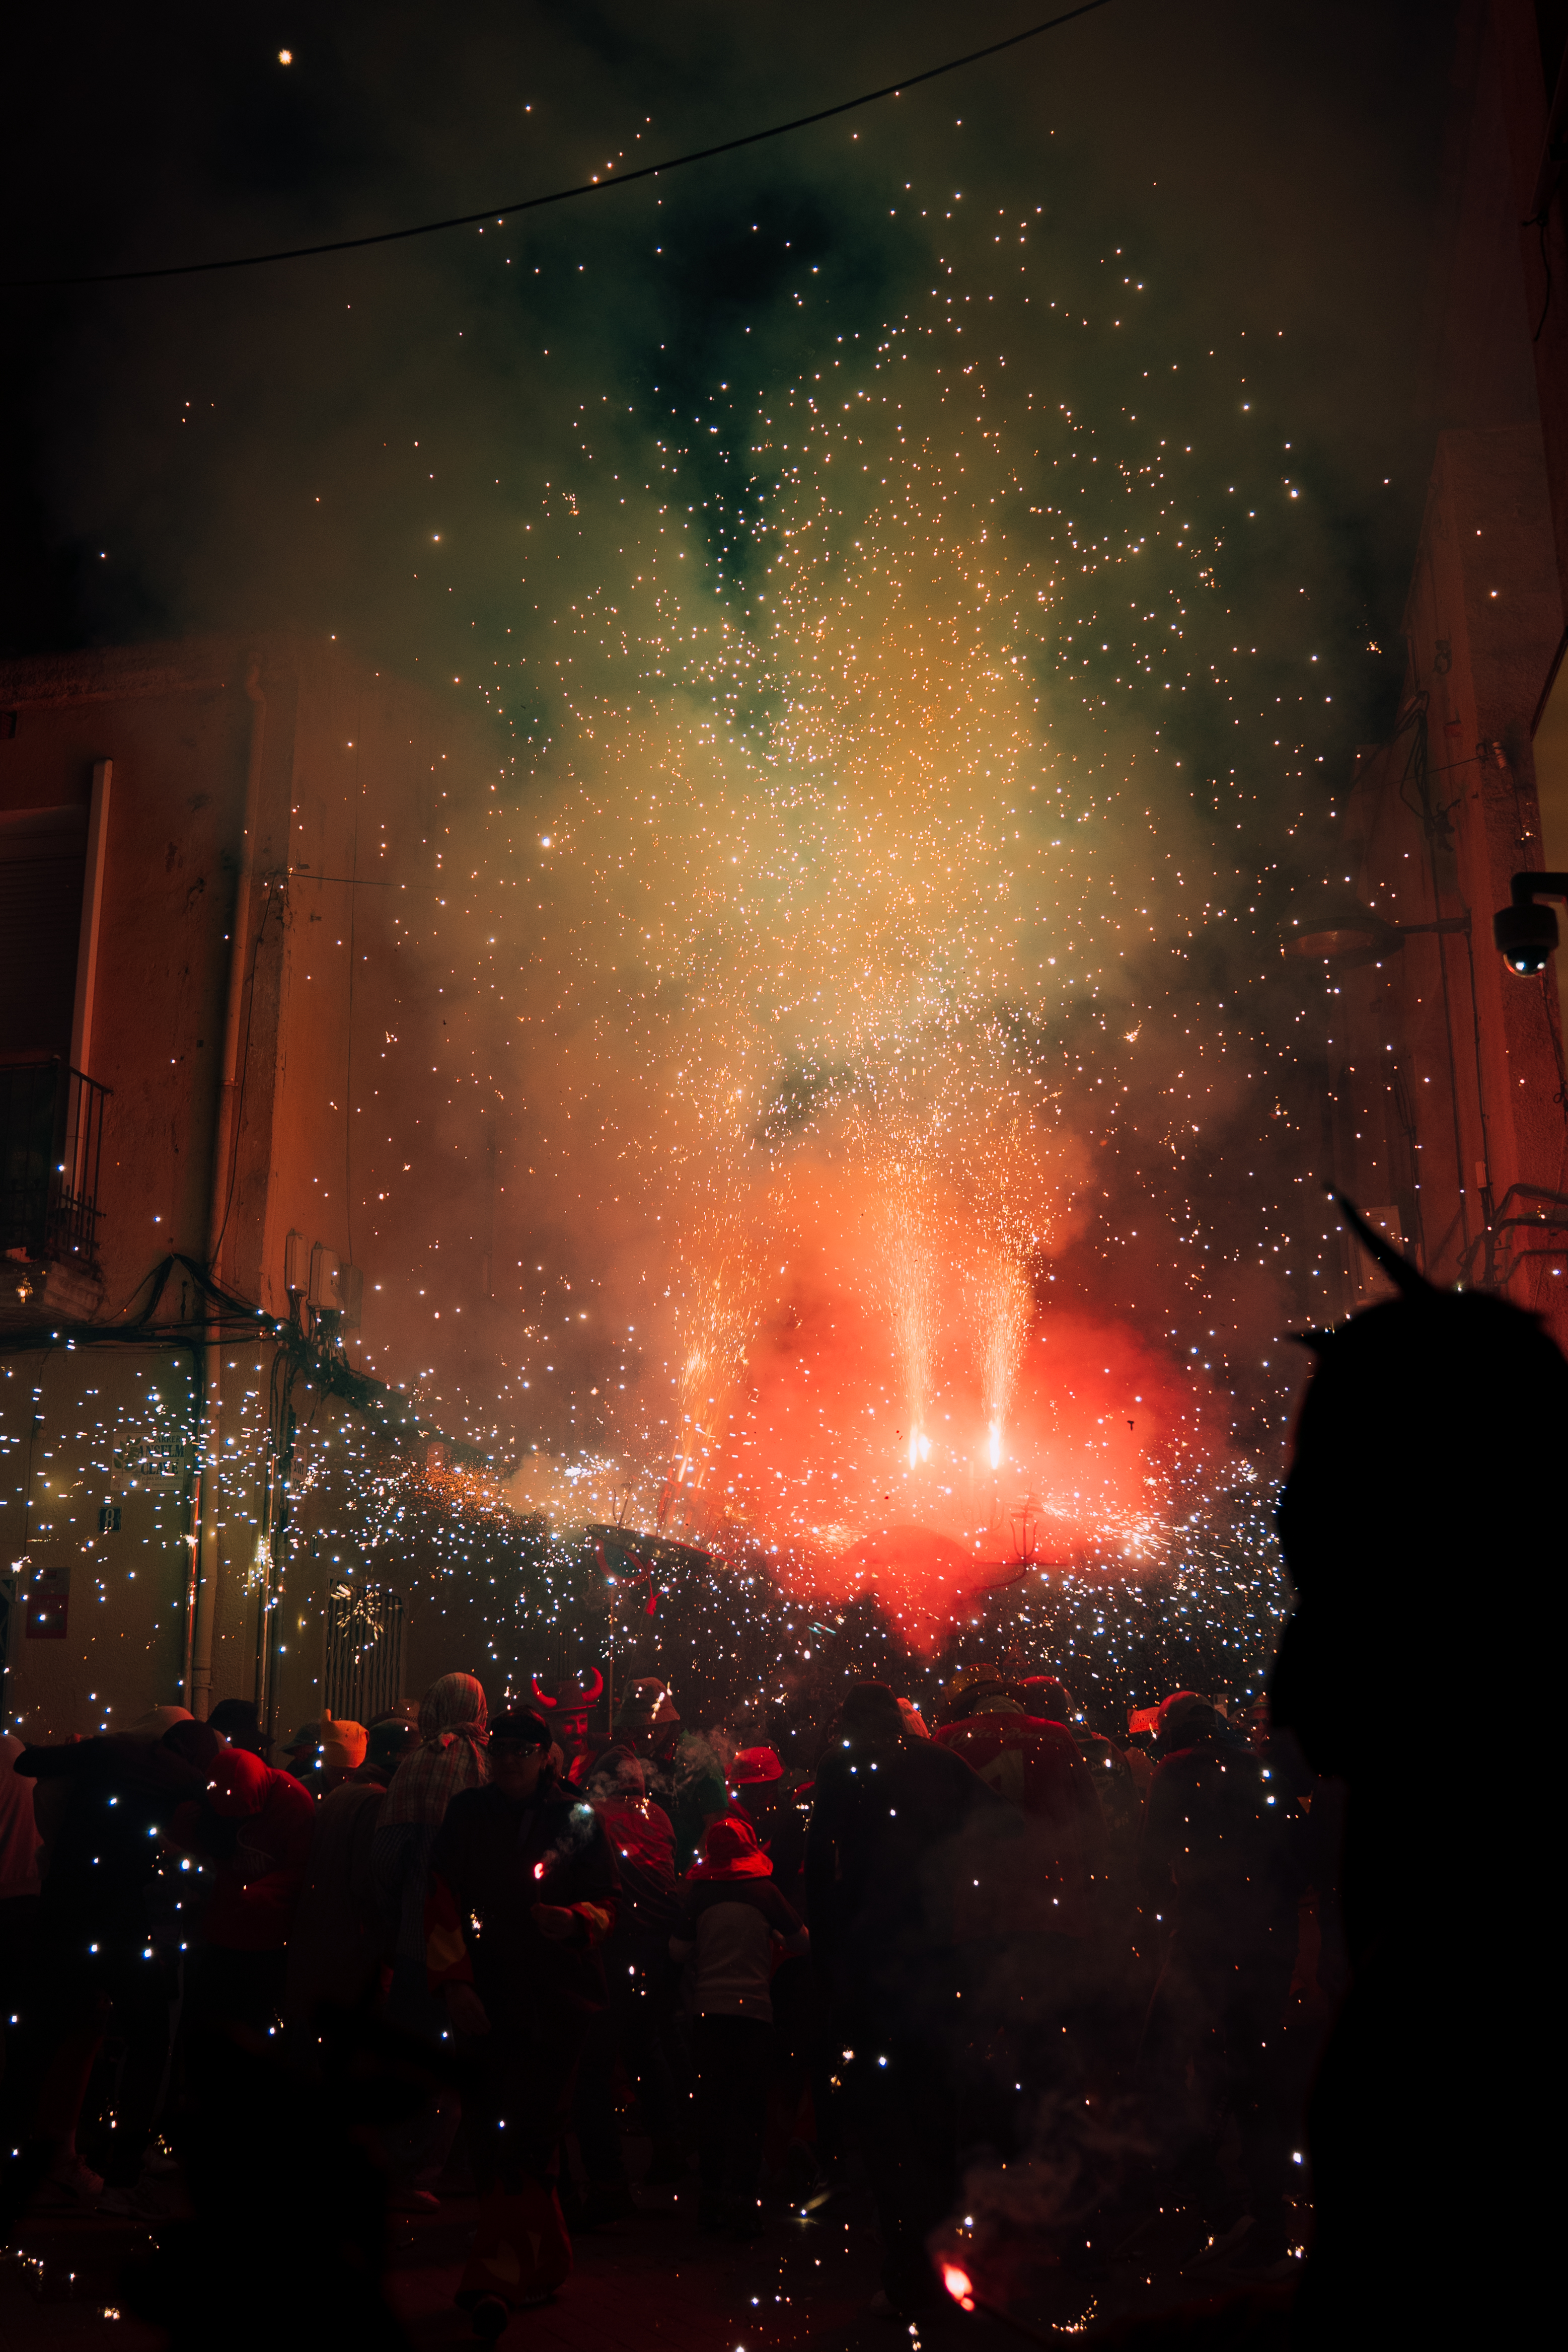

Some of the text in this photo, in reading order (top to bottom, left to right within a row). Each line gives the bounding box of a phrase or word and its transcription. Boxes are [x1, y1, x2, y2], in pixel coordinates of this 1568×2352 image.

[152, 1435, 180, 1443] CARRER
[137, 1444, 184, 1458] ANSELM
[105, 1508, 115, 1530] 8
